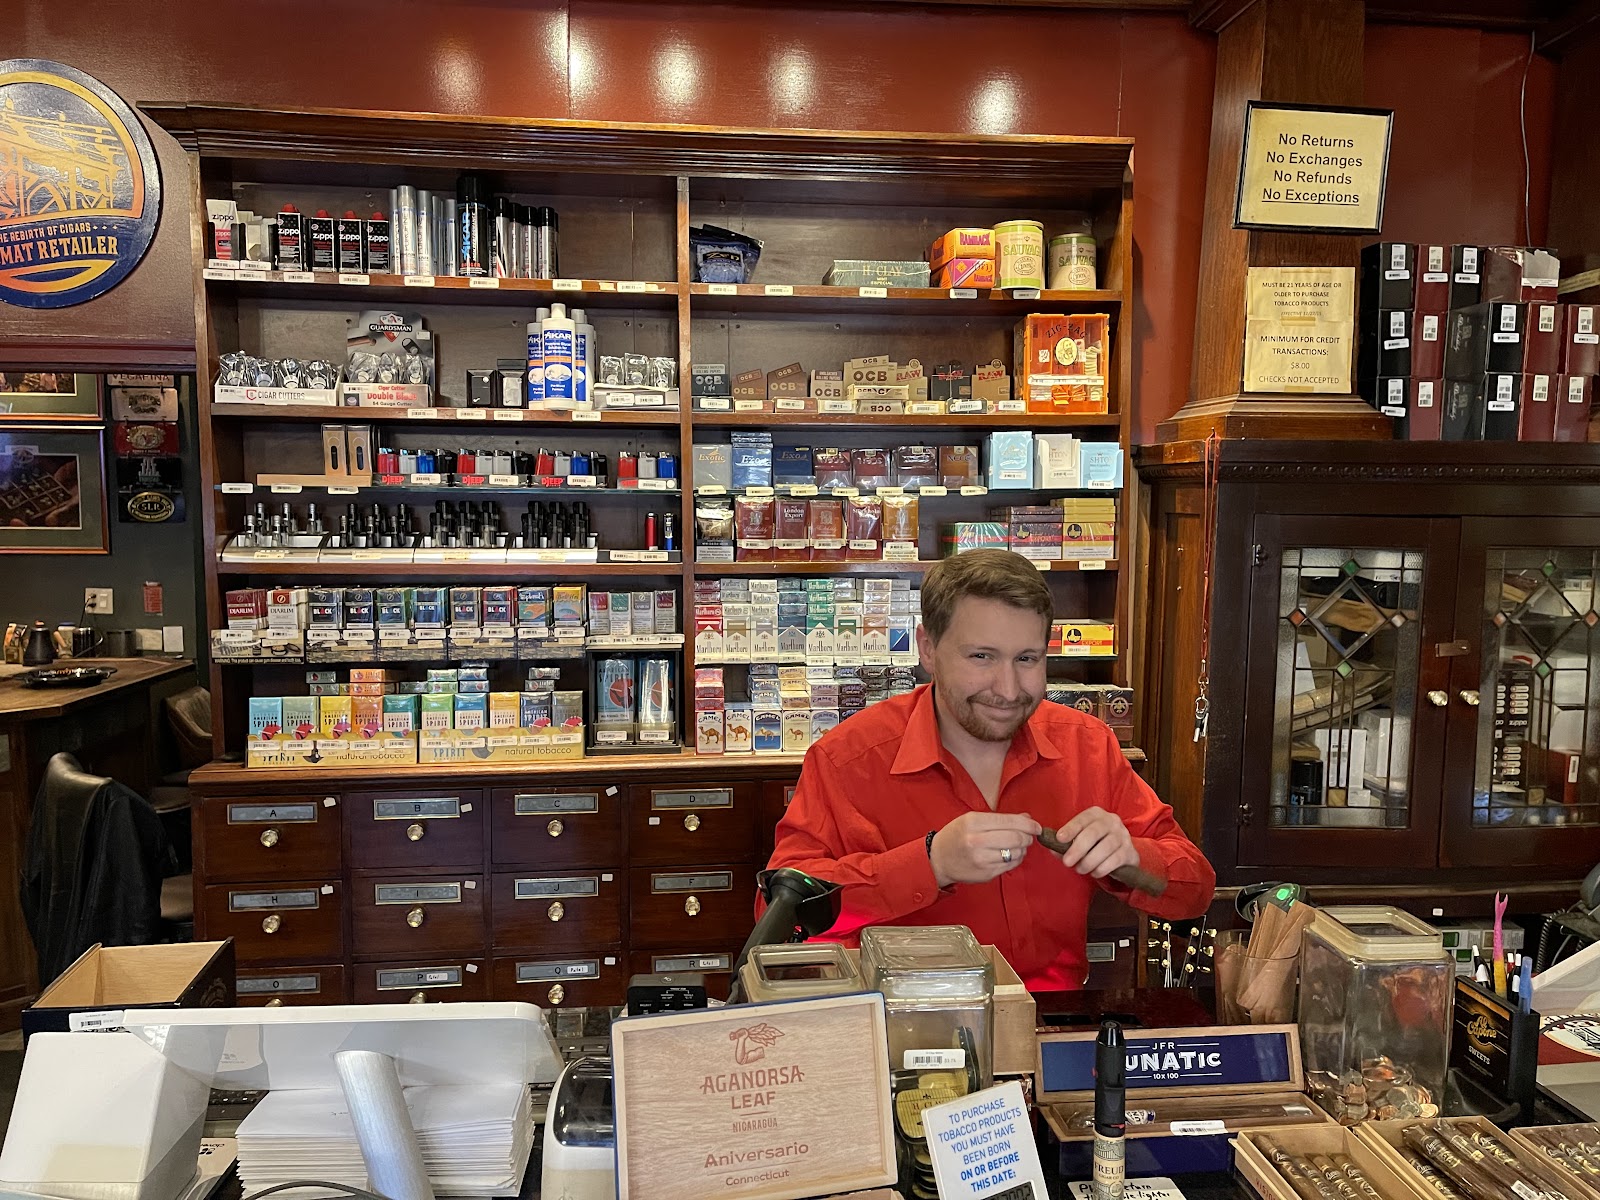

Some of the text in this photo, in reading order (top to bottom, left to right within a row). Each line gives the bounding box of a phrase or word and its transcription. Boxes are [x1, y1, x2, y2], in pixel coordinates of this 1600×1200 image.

[1279, 133, 1354, 148] No Returns
[1266, 151, 1363, 169] No Exchanges
[1273, 170, 1352, 185] No Refunds
[1262, 188, 1359, 204] No Exceptions
[212, 214, 234, 222] zippo
[9, 222, 91, 242] REBIRTH OF CIGARS
[277, 228, 300, 236] zippo
[312, 233, 334, 241] zippo
[339, 234, 361, 242] zippo
[367, 235, 389, 243] zippo
[37, 236, 119, 260] RETAILER
[876, 265, 903, 277] CLAY
[370, 324, 412, 332] GUARDSMAN
[1272, 348, 1329, 356] TRANSACTIONS:
[1290, 362, 1310, 370] $8.00
[777, 368, 793, 377] OCB
[853, 370, 888, 382] OCB
[896, 369, 921, 381] RAW
[978, 370, 1004, 381] RAW
[695, 375, 723, 385] OCB
[733, 387, 755, 395] OCB
[770, 382, 796, 391] OCB
[258, 391, 306, 400] CIGAR CUTTERS
[367, 392, 394, 400] Double
[815, 388, 841, 397] OCB
[698, 451, 727, 463] Exotic
[140, 502, 161, 511] SLR
[229, 607, 254, 615] DJARUM
[270, 607, 294, 615] DJARUM
[454, 605, 474, 613] BLACK
[487, 605, 506, 613] BLACK
[780, 639, 805, 651] Marlboro
[808, 640, 833, 652] Marlboro
[836, 640, 859, 652] Marlboro
[863, 639, 887, 651] Marlboro
[755, 680, 779, 688] CAMEL
[698, 715, 722, 724] CAMEL
[726, 713, 751, 721] CAMEL
[756, 713, 780, 721] CAMEL
[505, 746, 572, 756] natural tobacco
[554, 800, 561, 808] C
[689, 795, 696, 803] D
[269, 809, 277, 817] A
[414, 804, 421, 812] B
[553, 883, 560, 891] J
[689, 878, 695, 886] F
[271, 896, 278, 904] H
[689, 960, 696, 968] R
[1475, 1015, 1488, 1029] Al
[1466, 1020, 1497, 1039] Capone
[1152, 1041, 1175, 1050] JFR
[1468, 1045, 1491, 1065] SWEETS
[1125, 1051, 1222, 1072] UNATIC
[700, 1065, 805, 1095] AGANORSA
[731, 1091, 776, 1110] LEAF
[949, 1098, 1006, 1125] TO PURCHASE
[732, 1117, 778, 1133] NICARAGUA
[938, 1107, 1022, 1144] TOBACCO PRODUCTS
[951, 1123, 1016, 1154] YOU MUST HAVE
[704, 1141, 809, 1168] Aniversario
[963, 1140, 1011, 1165] BEEN BORN
[960, 1151, 1020, 1182] ON OR BEFORE
[1094, 1161, 1124, 1175] FREUD
[725, 1169, 790, 1187] Connecticut
[971, 1169, 1017, 1193] THIS DATE:
